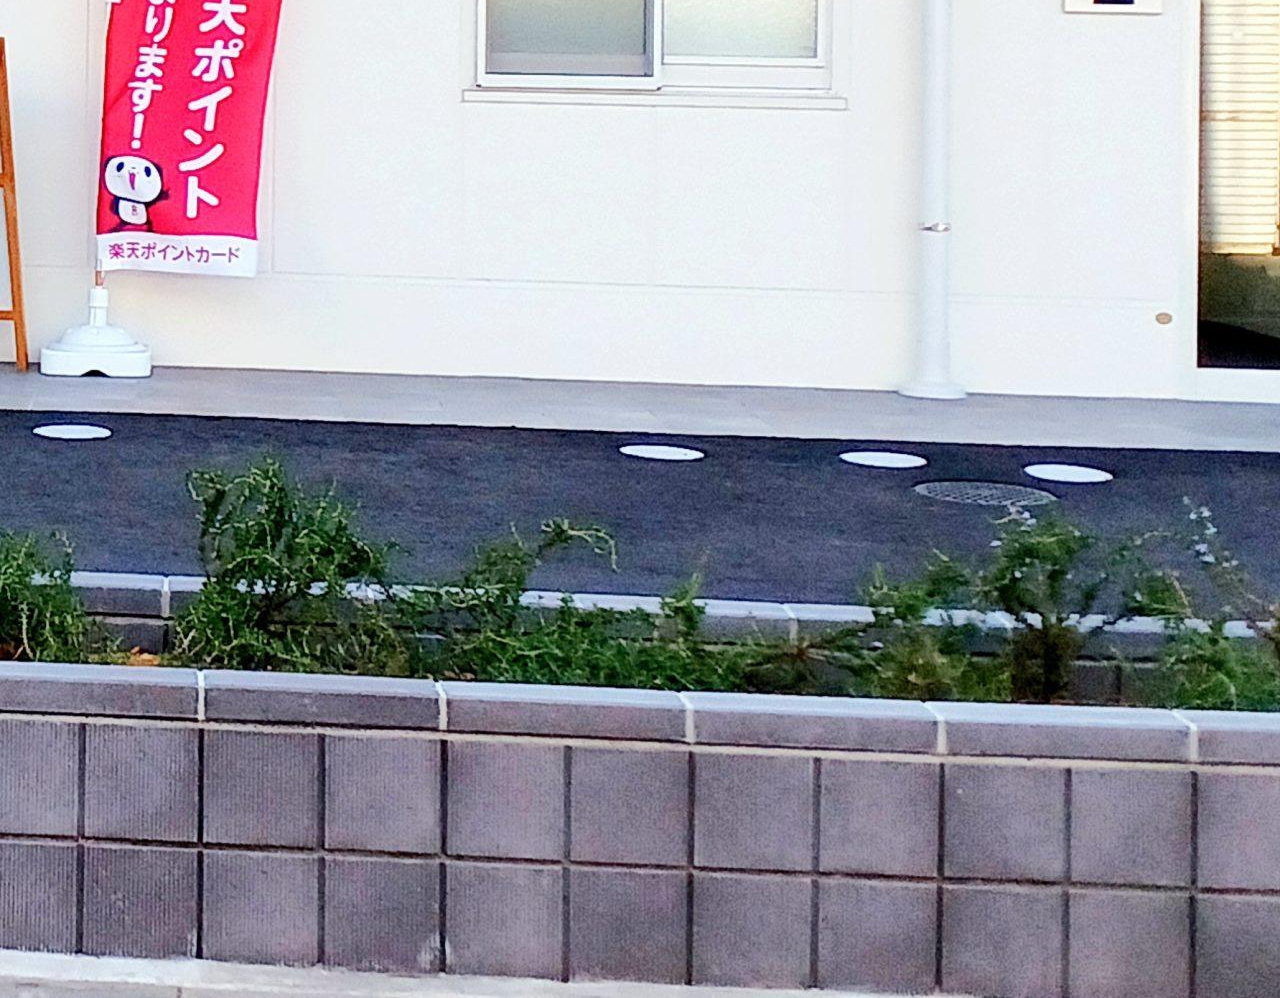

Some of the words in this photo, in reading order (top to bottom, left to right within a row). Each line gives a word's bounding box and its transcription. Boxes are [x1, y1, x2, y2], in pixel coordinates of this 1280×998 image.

[108, 242, 241, 264] 楽天ポイントカード
